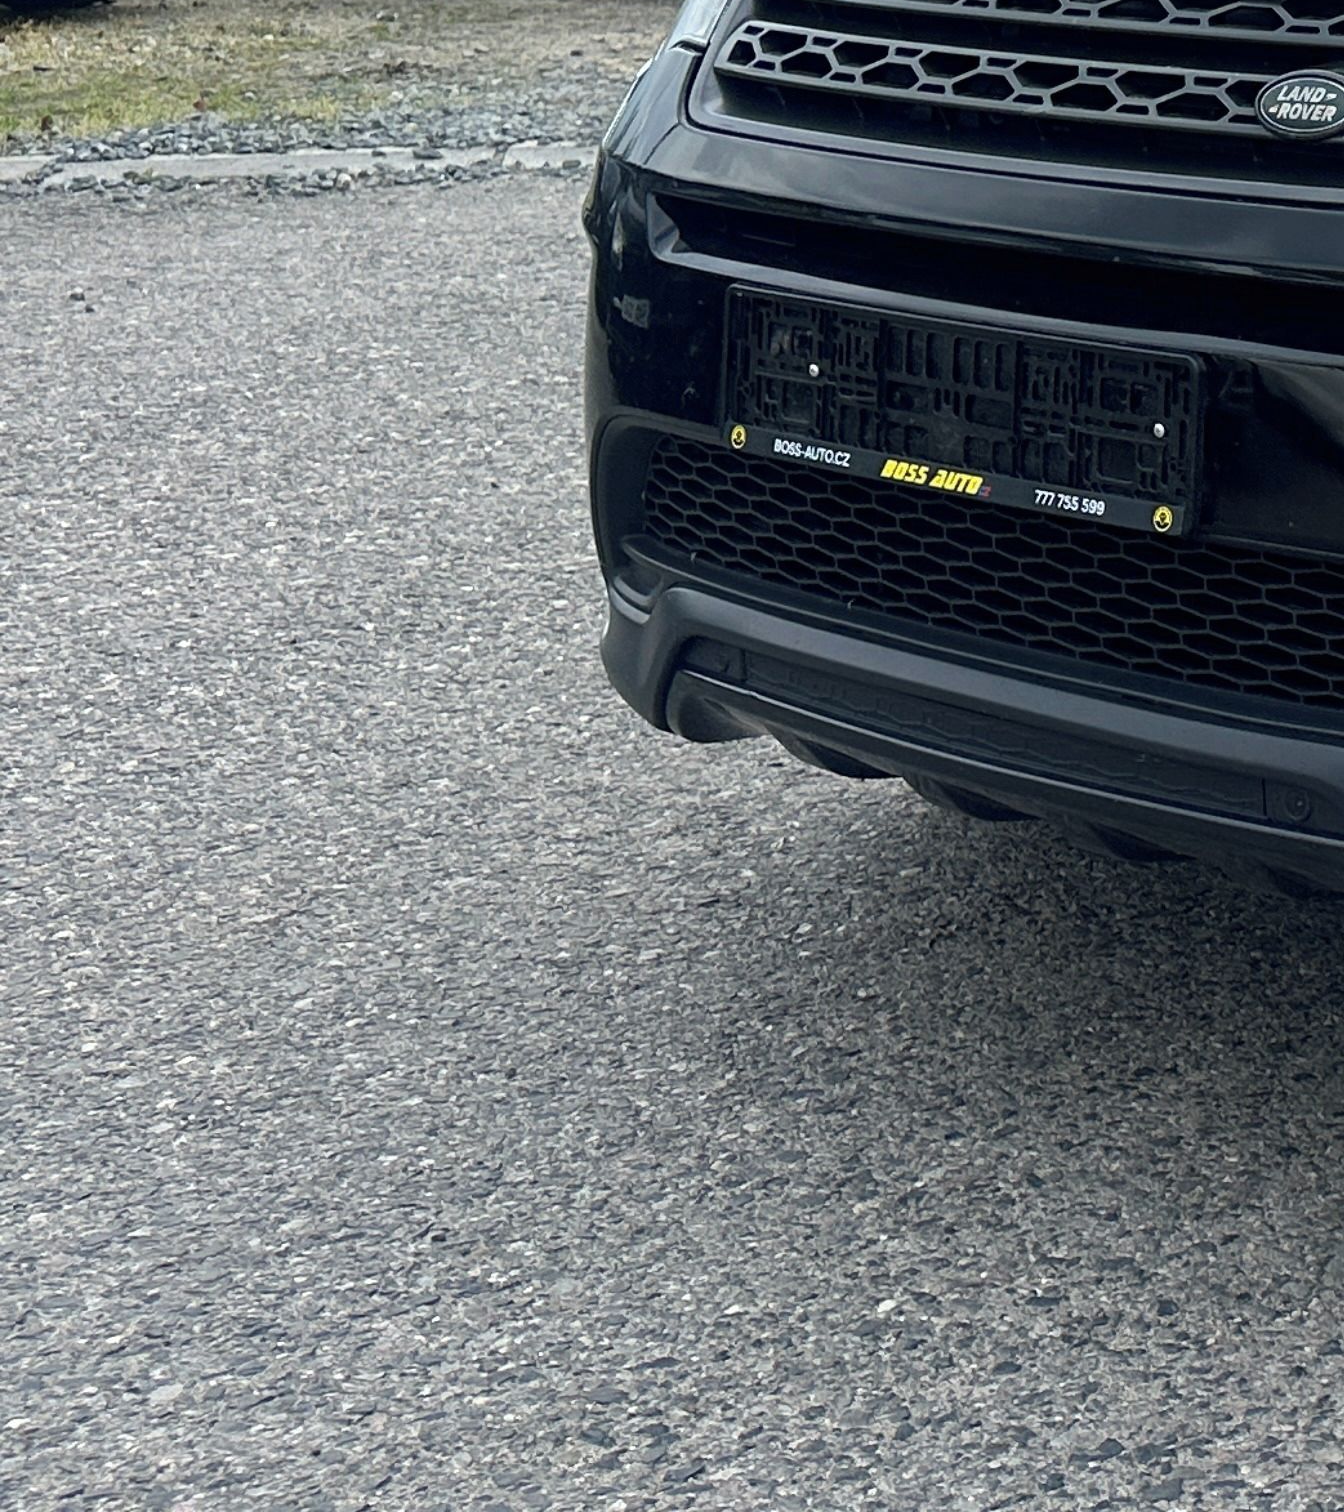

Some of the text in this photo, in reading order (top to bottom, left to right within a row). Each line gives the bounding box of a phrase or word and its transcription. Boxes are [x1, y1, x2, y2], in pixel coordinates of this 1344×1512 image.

[773, 438, 851, 468] BOSS-AUTO.CZ
[880, 459, 930, 485] BOSS
[929, 468, 984, 496] AUTO
[1034, 489, 1055, 507] 777
[1057, 493, 1079, 512] 755
[1081, 497, 1106, 516] 599
